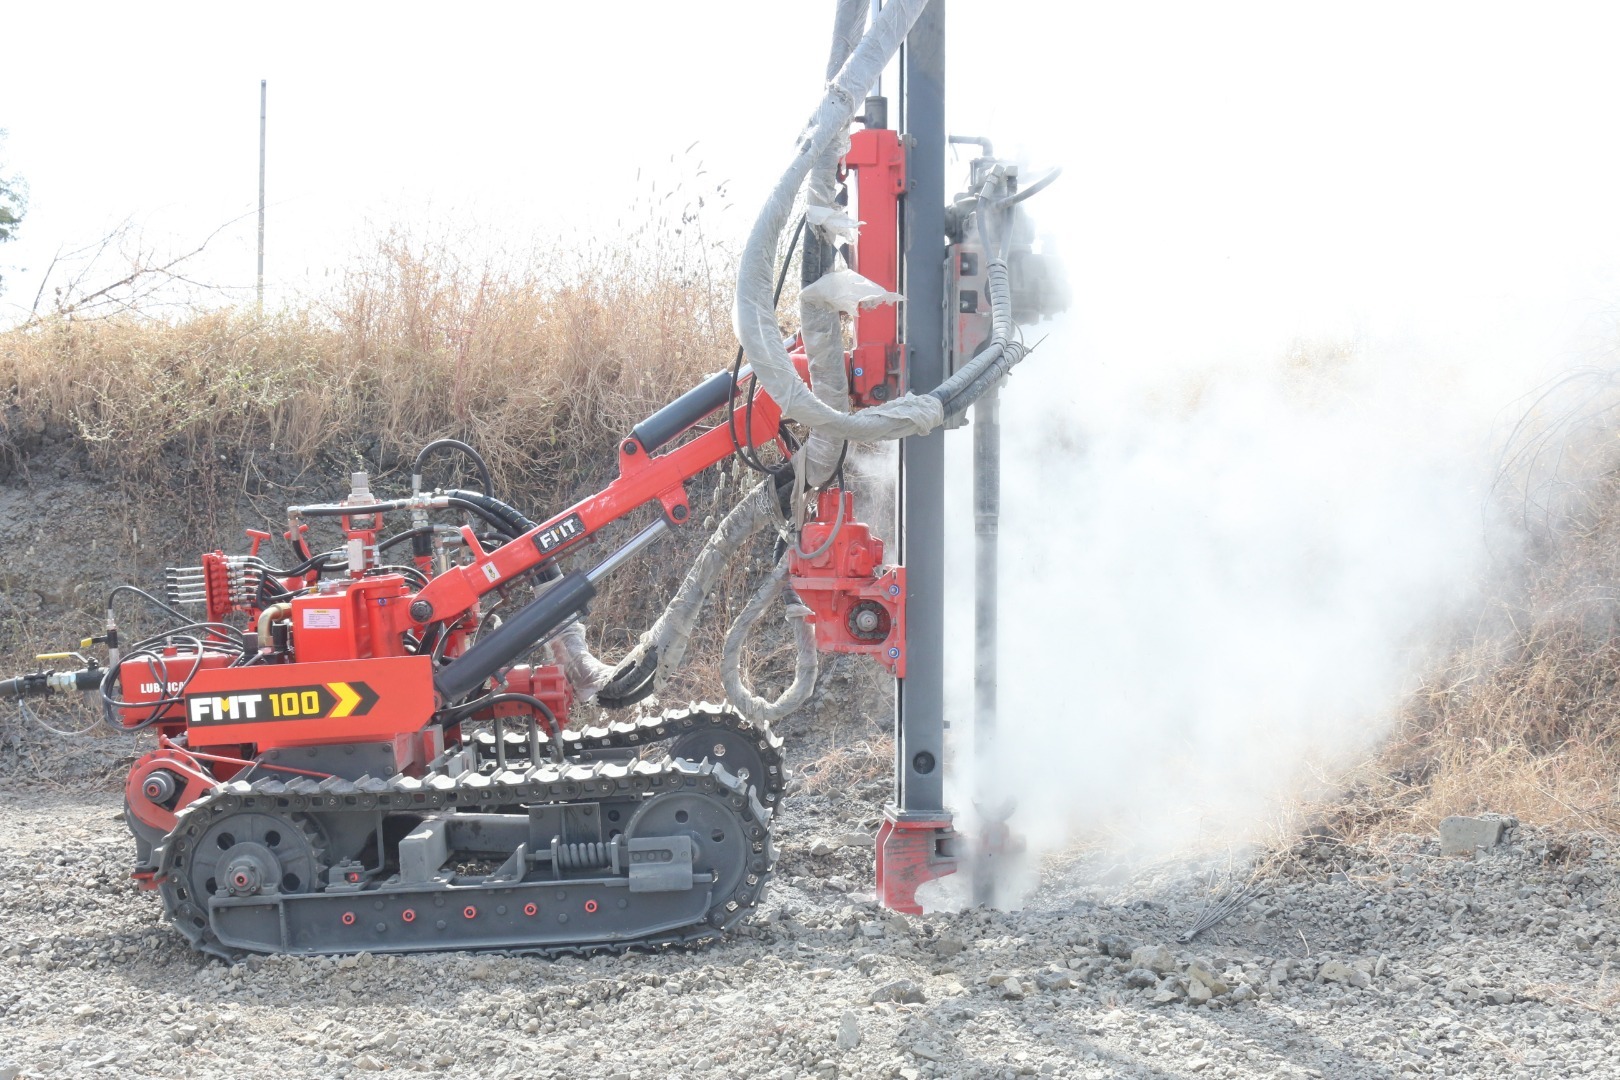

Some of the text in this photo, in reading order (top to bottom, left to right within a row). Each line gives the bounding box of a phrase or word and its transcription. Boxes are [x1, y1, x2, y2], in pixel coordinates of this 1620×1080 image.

[539, 518, 576, 549] FMT
[190, 691, 320, 722] FMT 100
